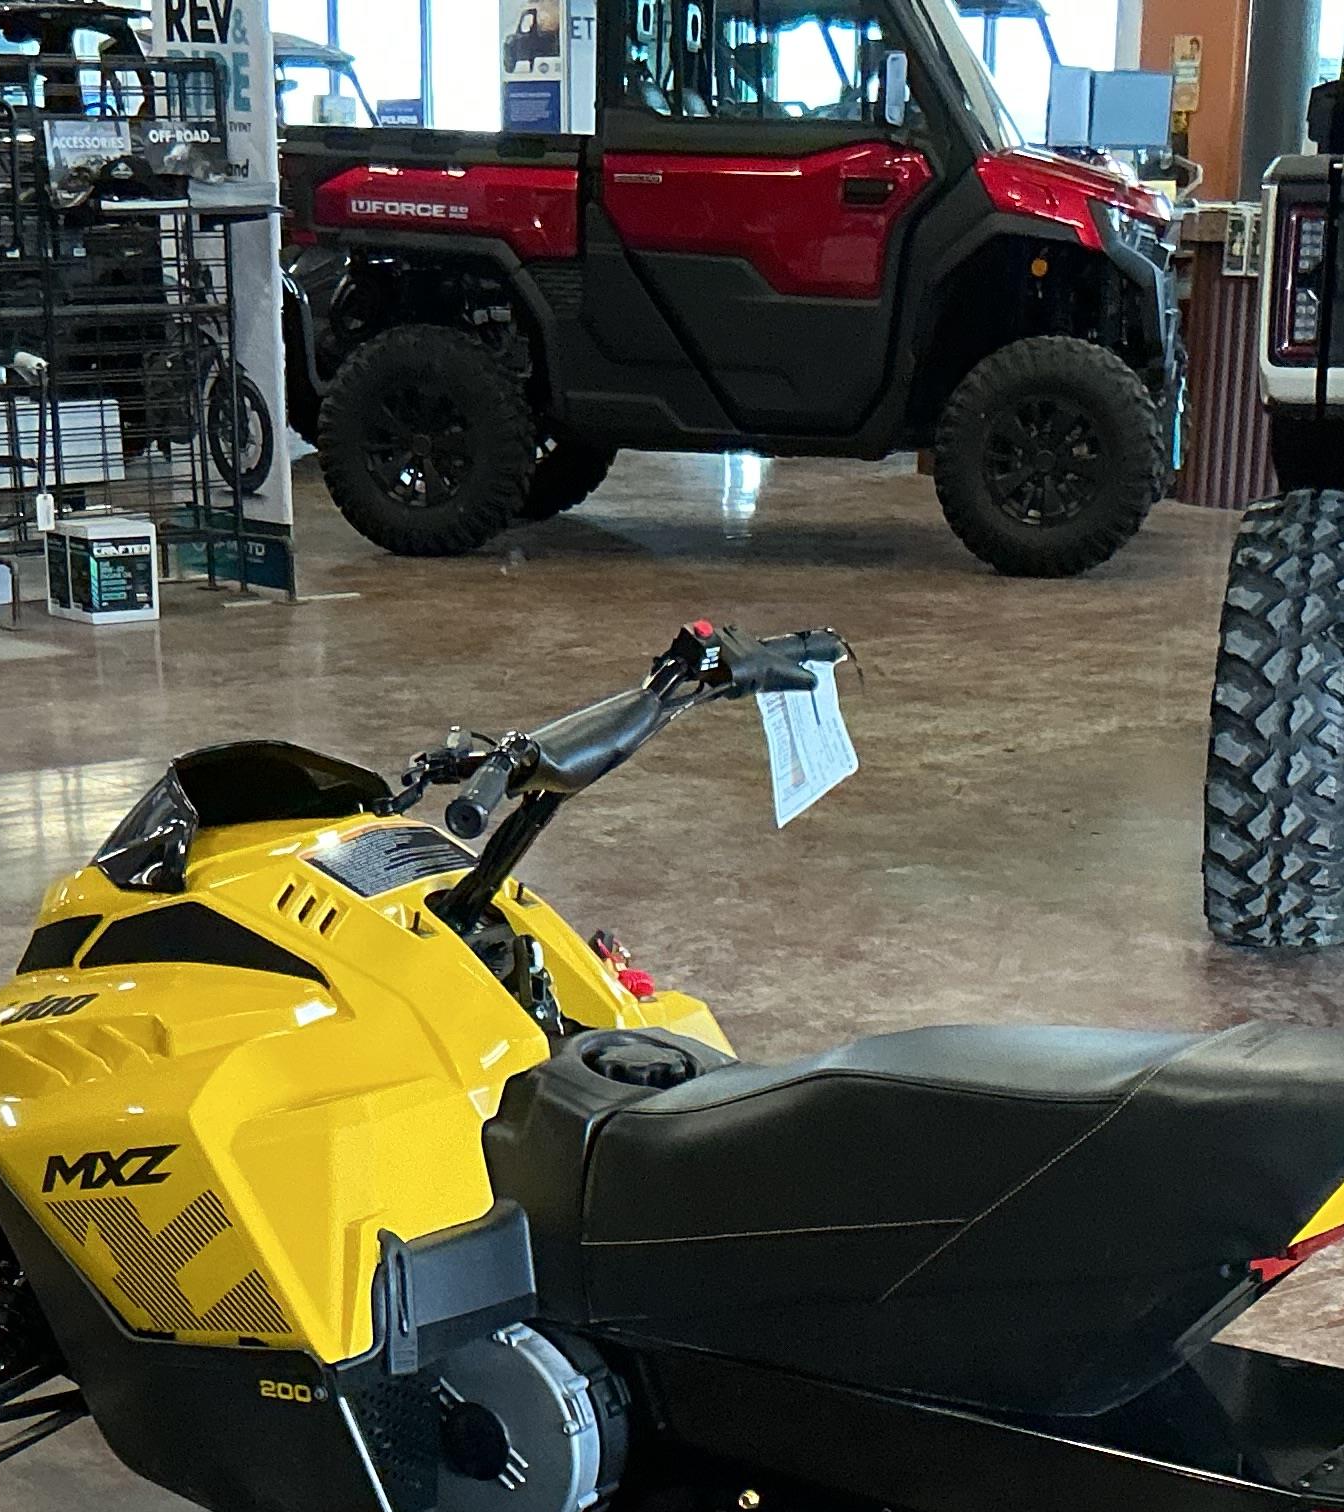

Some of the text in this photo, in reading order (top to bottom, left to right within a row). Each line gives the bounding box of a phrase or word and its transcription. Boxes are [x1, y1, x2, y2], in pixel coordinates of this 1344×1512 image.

[164, 0, 234, 44] REV
[52, 136, 125, 149] ACCESSORIES
[41, 1143, 182, 1194] MXZ
[259, 1379, 312, 1403] 200
